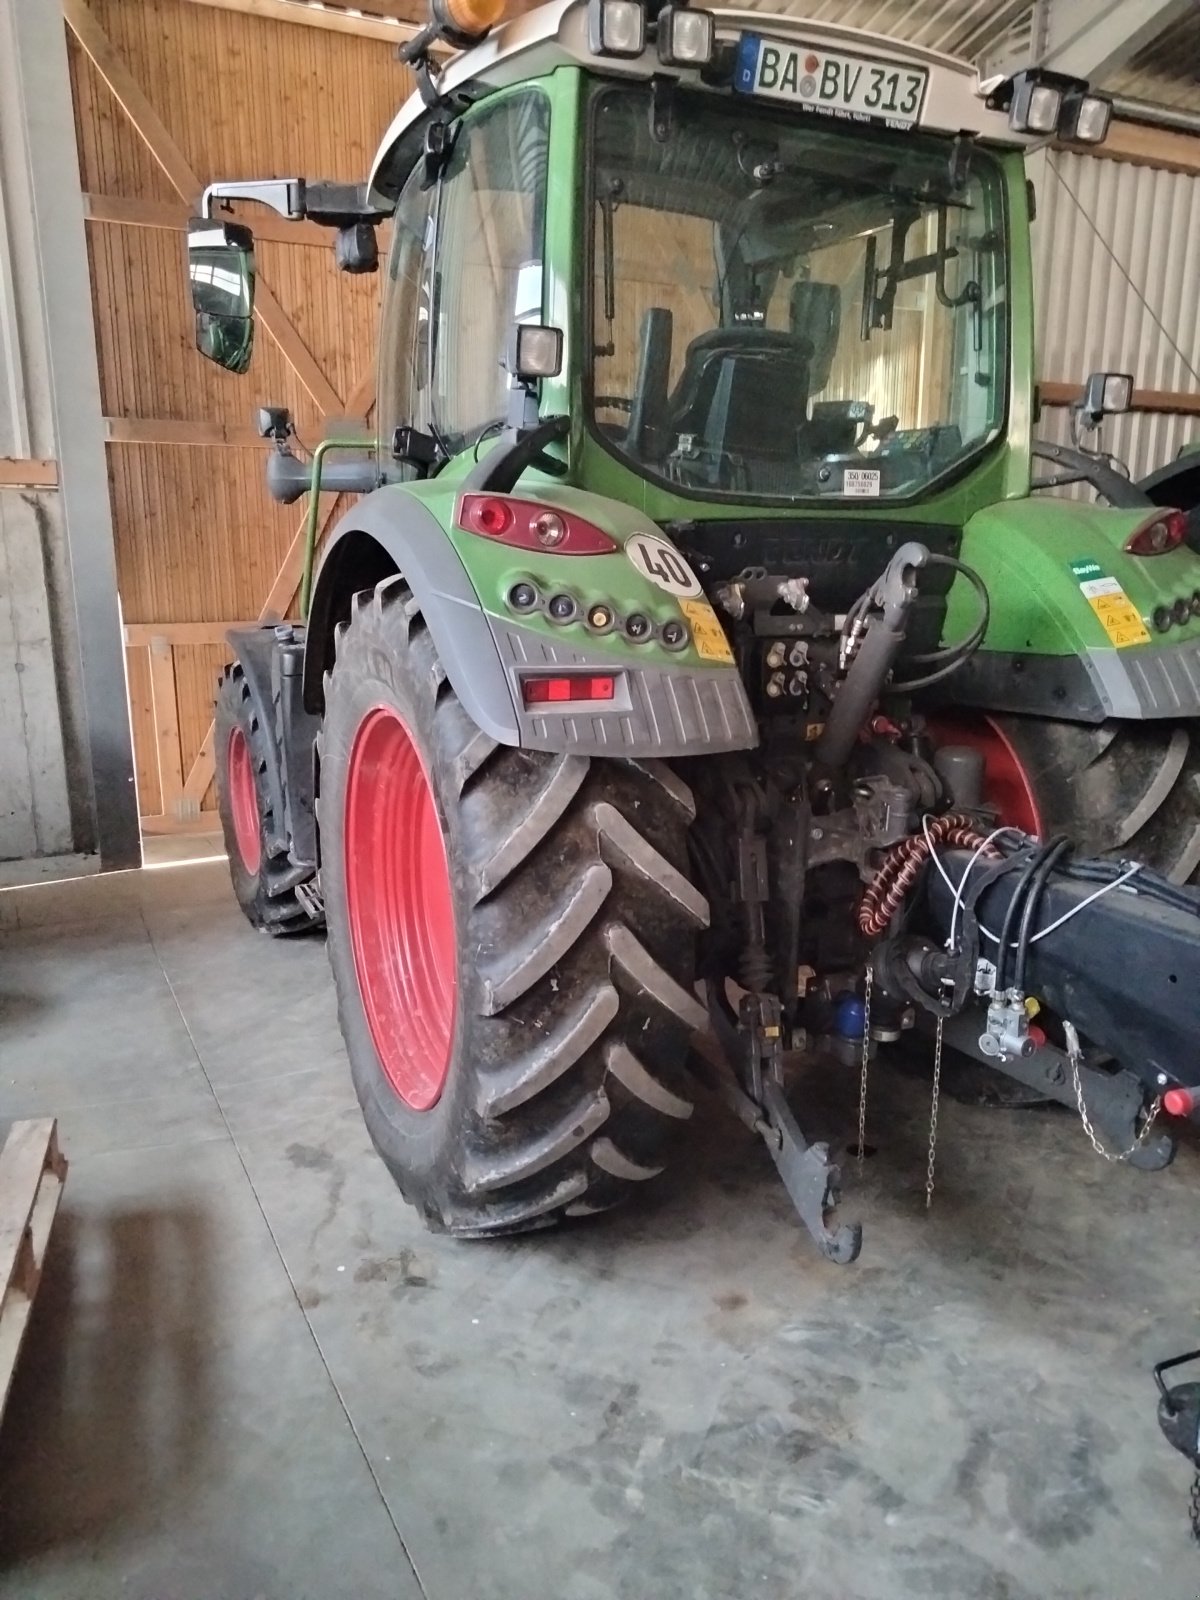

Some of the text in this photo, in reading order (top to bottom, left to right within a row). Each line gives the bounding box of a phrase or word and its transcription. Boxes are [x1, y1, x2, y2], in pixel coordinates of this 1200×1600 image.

[742, 69, 751, 82] D
[758, 47, 922, 114] BA BV 313
[637, 542, 693, 588] 40
